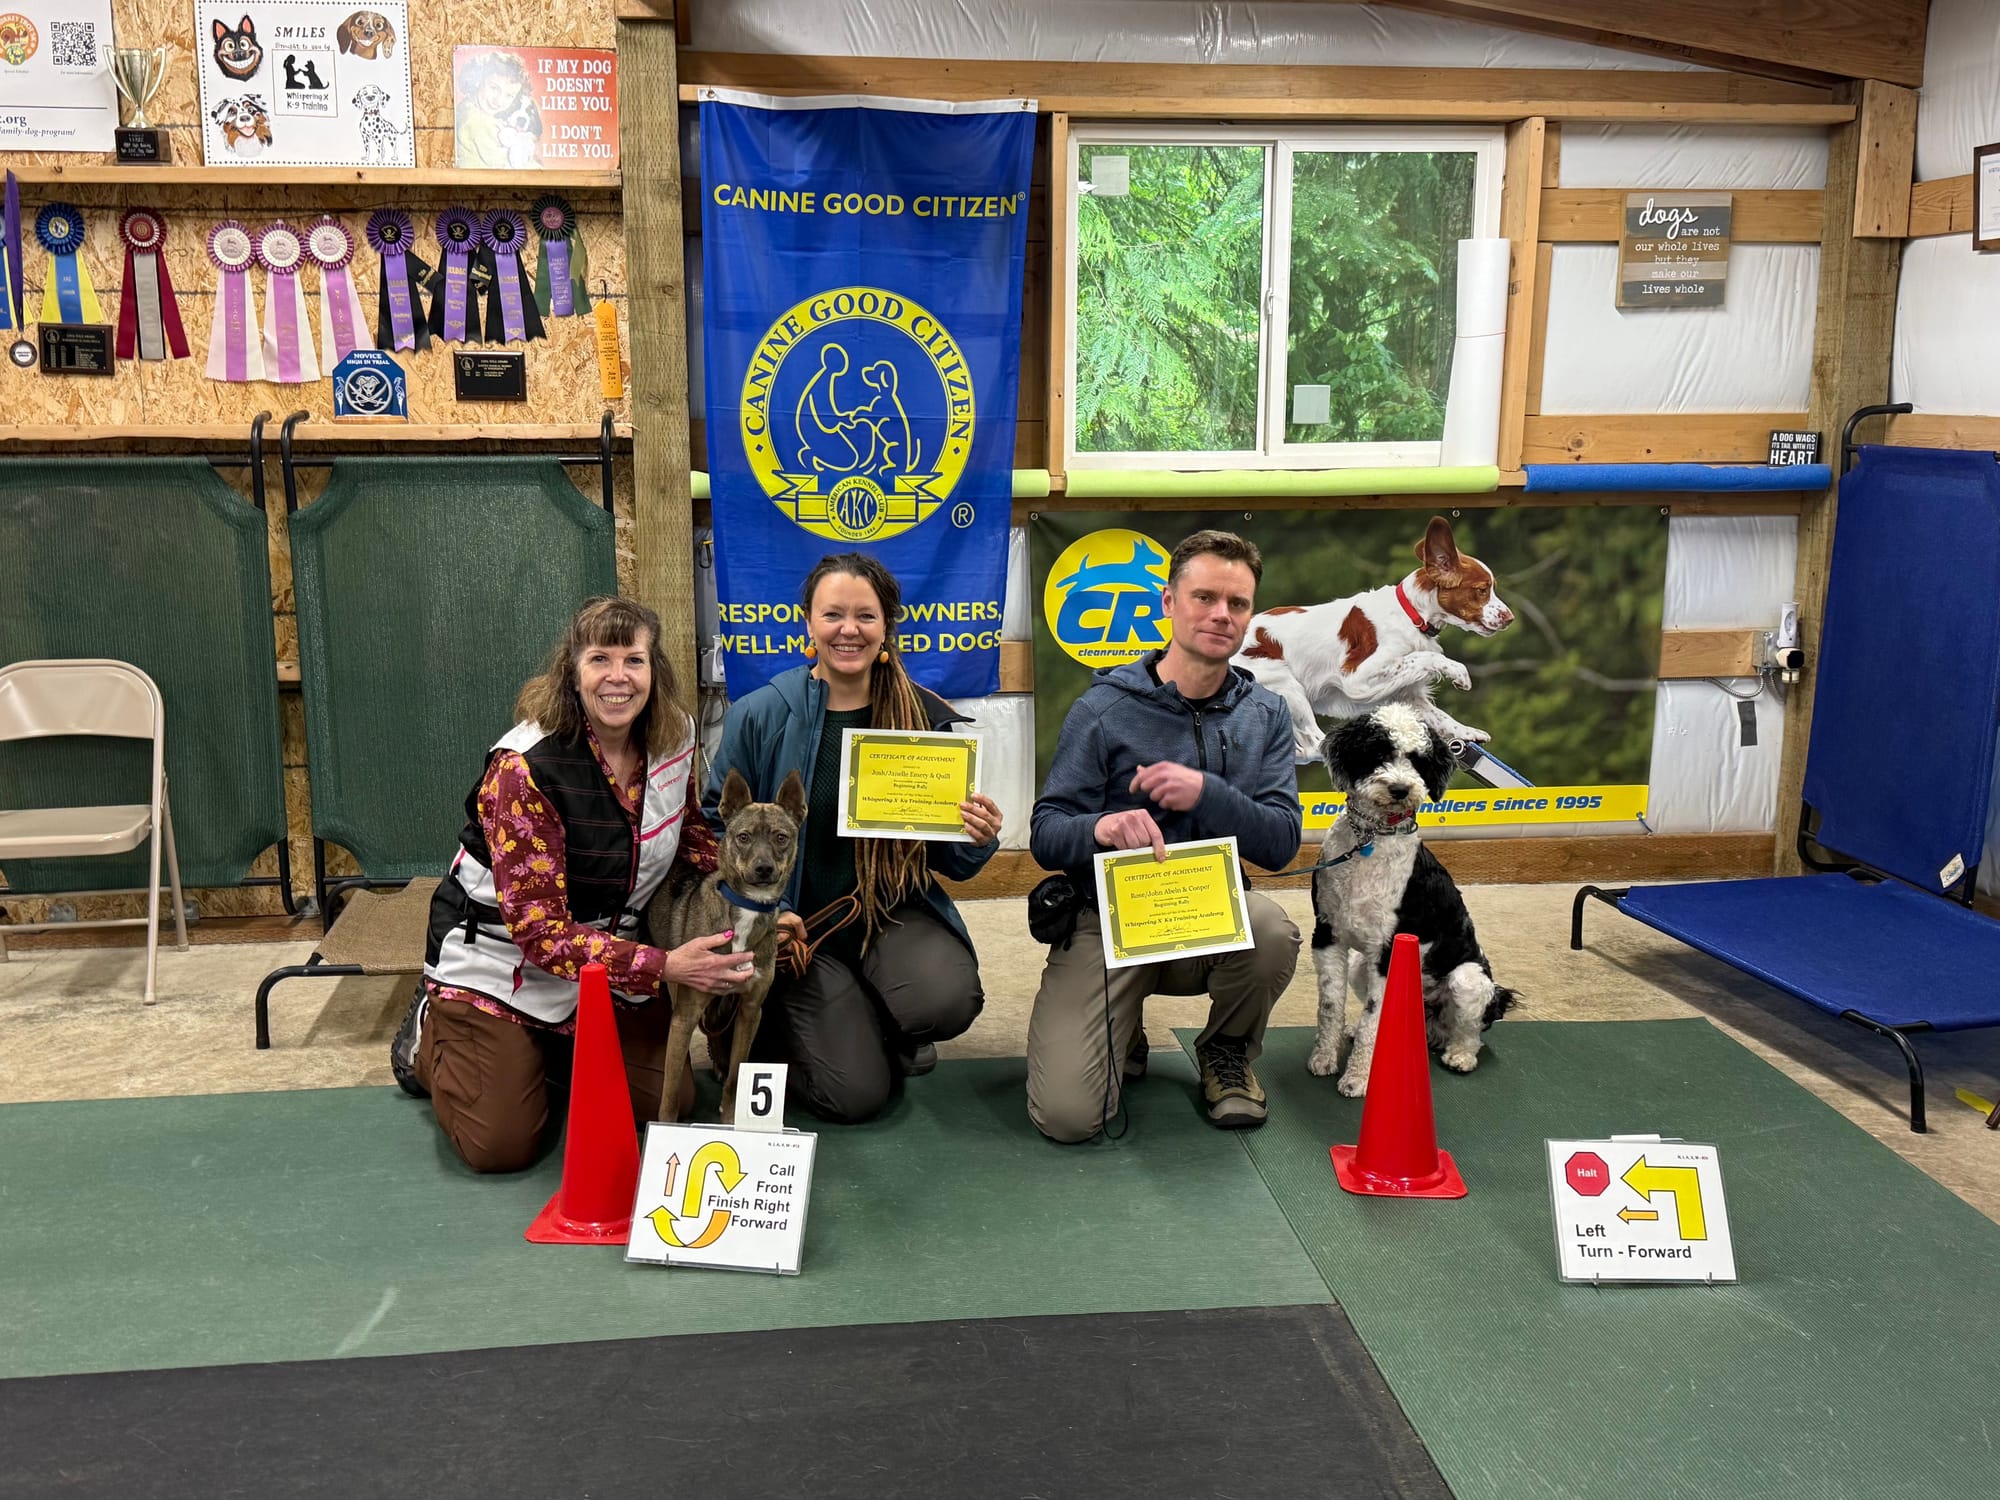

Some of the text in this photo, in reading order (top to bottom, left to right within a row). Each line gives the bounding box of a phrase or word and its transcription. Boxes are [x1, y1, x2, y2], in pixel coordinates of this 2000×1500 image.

[274, 26, 326, 38] SMILES
[537, 58, 612, 74] IF MY DOG
[545, 77, 605, 93] DOESN'T
[286, 91, 322, 101] Whispering
[286, 100, 328, 112] K-9 Training
[541, 96, 613, 114] LIKE YOU,
[551, 125, 603, 140] I DON'T
[542, 143, 614, 159] LIKE YOU.
[713, 184, 816, 213] CANINE
[823, 193, 905, 215] GOOD
[1638, 198, 1698, 240] dogs
[1681, 226, 1721, 236] are not
[1635, 242, 1720, 252] our whole lives
[1654, 255, 1700, 267] but they
[1651, 269, 1700, 279] make our
[1641, 284, 1705, 294] lives whole
[745, 314, 805, 437] CANINE
[809, 292, 904, 323] GOOD
[911, 315, 971, 441] CITIZEN
[1772, 432, 1817, 443] A DOG WAGS
[1770, 450, 1815, 465] HEART
[829, 479, 885, 513] AMERICAN KENNEL CLUB
[839, 488, 875, 529] AKC
[717, 603, 808, 623] RESPON
[1056, 590, 1166, 644] CR
[720, 633, 805, 654] ELL-M
[915, 755, 956, 763] ACHIEVEMENT
[1492, 797, 1548, 812] since
[1555, 795, 1603, 810] 1995
[1124, 872, 1162, 882] CERTIFICATE
[1172, 866, 1213, 875] ACHIEVEMENT
[1124, 918, 1156, 928] Whispering
[1173, 913, 1197, 922] Training
[750, 1072, 773, 1117] 5
[769, 1163, 796, 1177] Call
[1577, 1168, 1598, 1178] Halt
[756, 1181, 793, 1195] Front
[707, 1195, 791, 1213] Finish Right
[731, 1214, 788, 1231] Forward
[1575, 1224, 1607, 1238] Left
[1577, 1244, 1613, 1258] Turn
[1627, 1244, 1692, 1259] Forward
